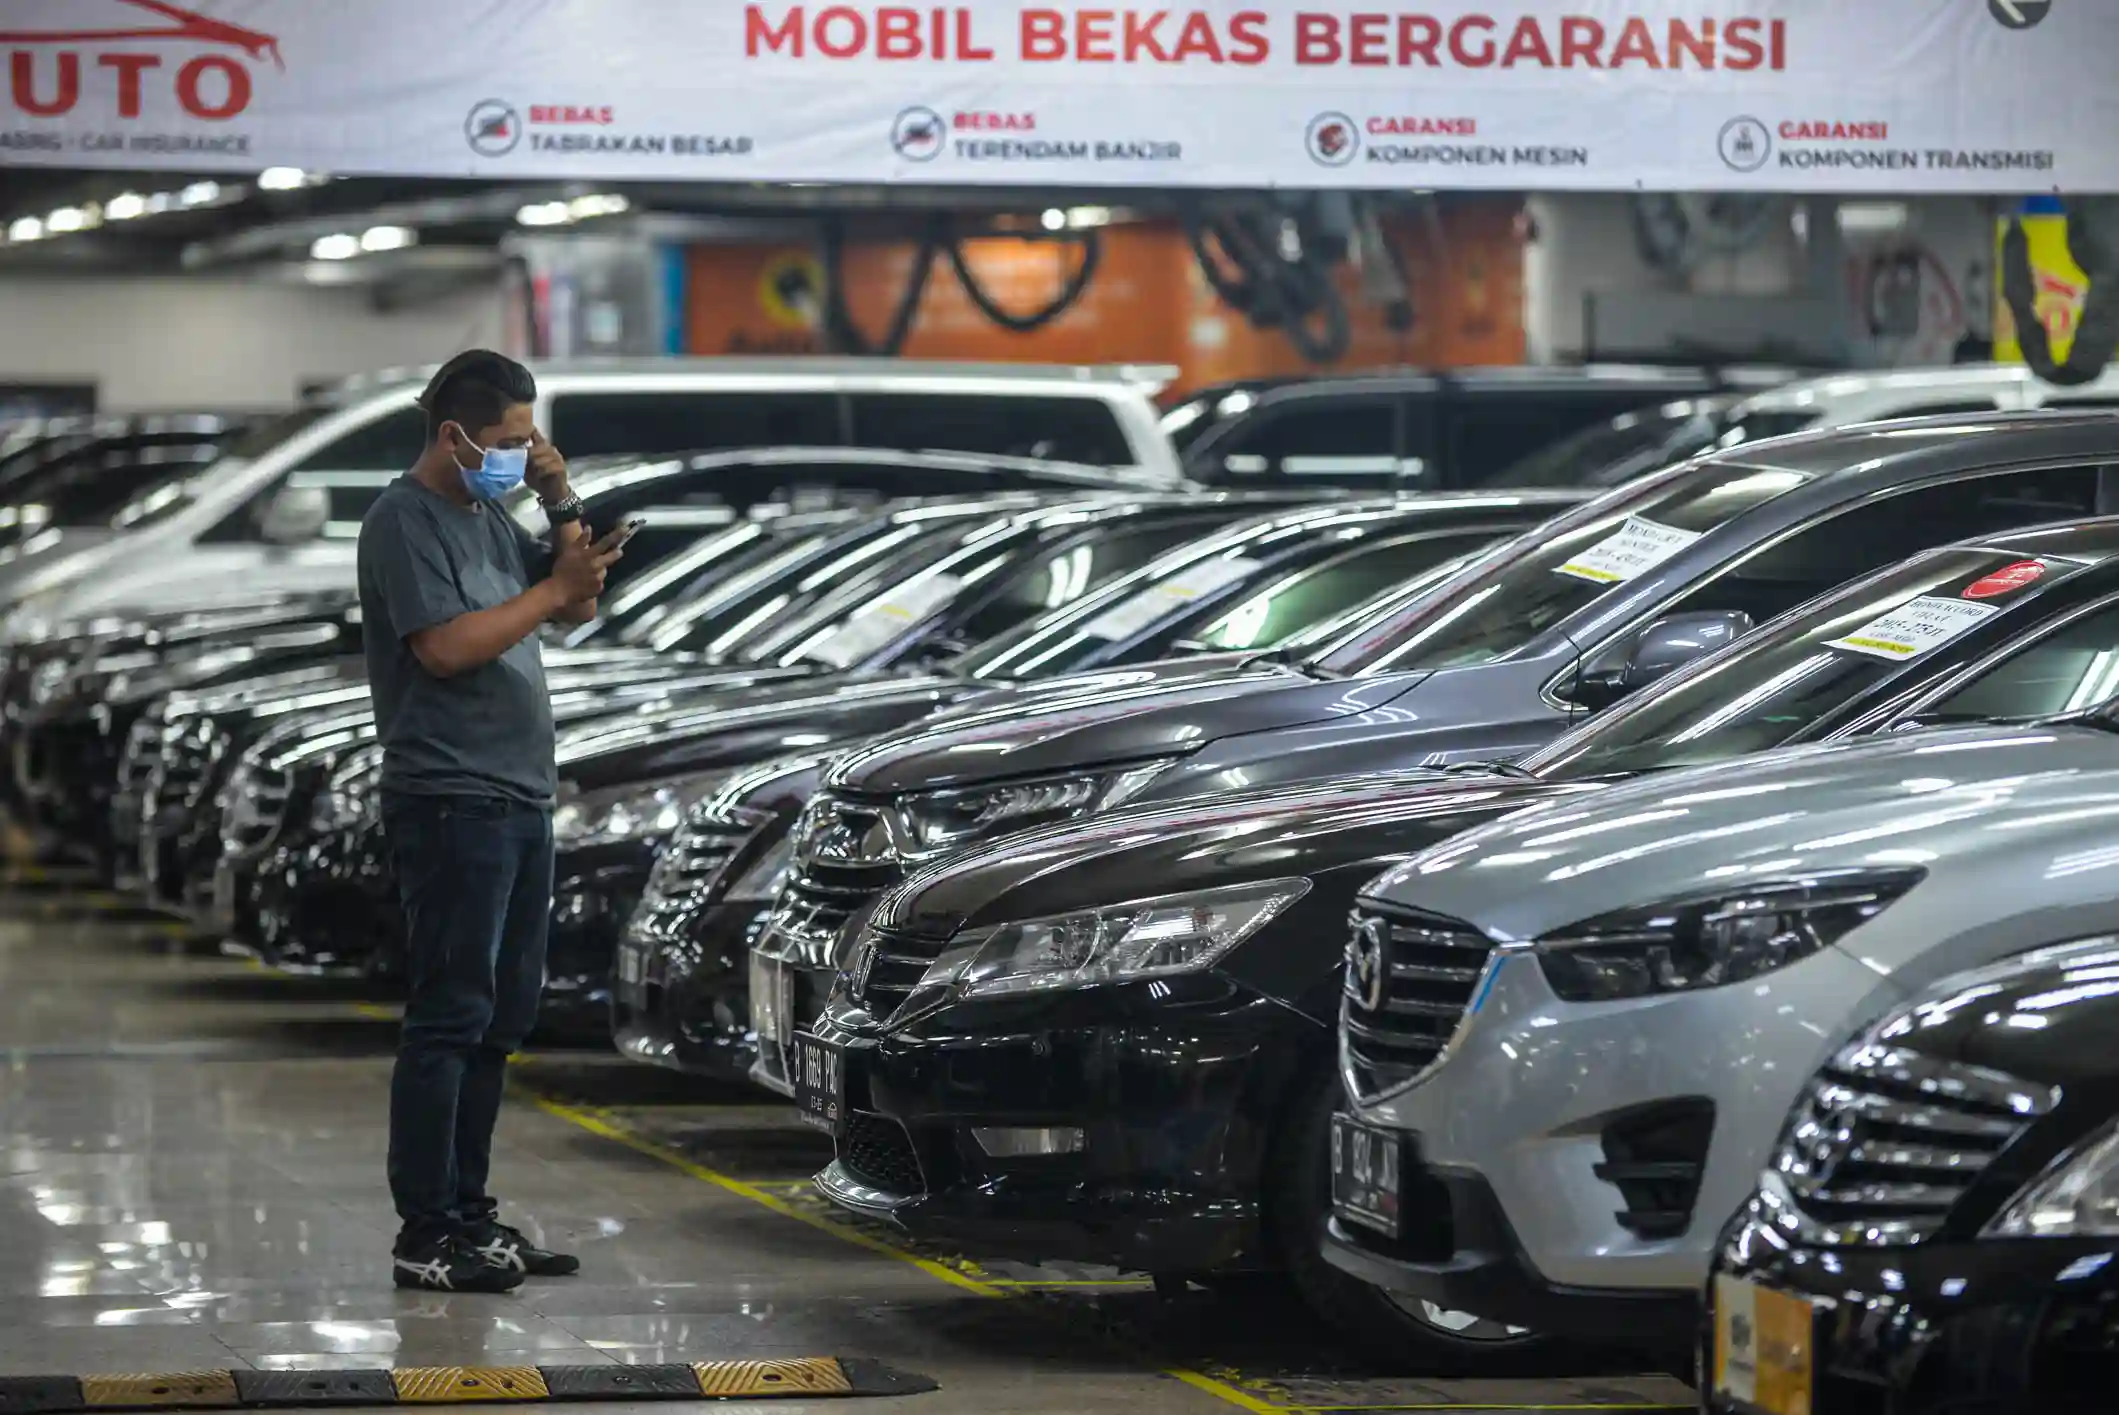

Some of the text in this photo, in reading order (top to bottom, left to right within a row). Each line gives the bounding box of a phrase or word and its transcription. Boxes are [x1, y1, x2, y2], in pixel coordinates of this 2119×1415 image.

[745, 5, 1786, 71] MOBIL BEKAS BERGARANSI
[529, 105, 613, 125] BEBAS
[953, 112, 1036, 131] BEBAS
[1366, 117, 1477, 136] GARANSI
[1778, 121, 1889, 140] GARANSI
[80, 133, 123, 151] CAR
[129, 134, 249, 155] INSURANCE
[529, 133, 753, 156] TABRAKAN BESAR
[954, 139, 1182, 161] TERENDAM BANJIR
[1365, 144, 1588, 167] KOMPONEN MESIN
[1778, 148, 2055, 170] KOMPONEN TRANSMISI
[794, 1040, 801, 1083] B
